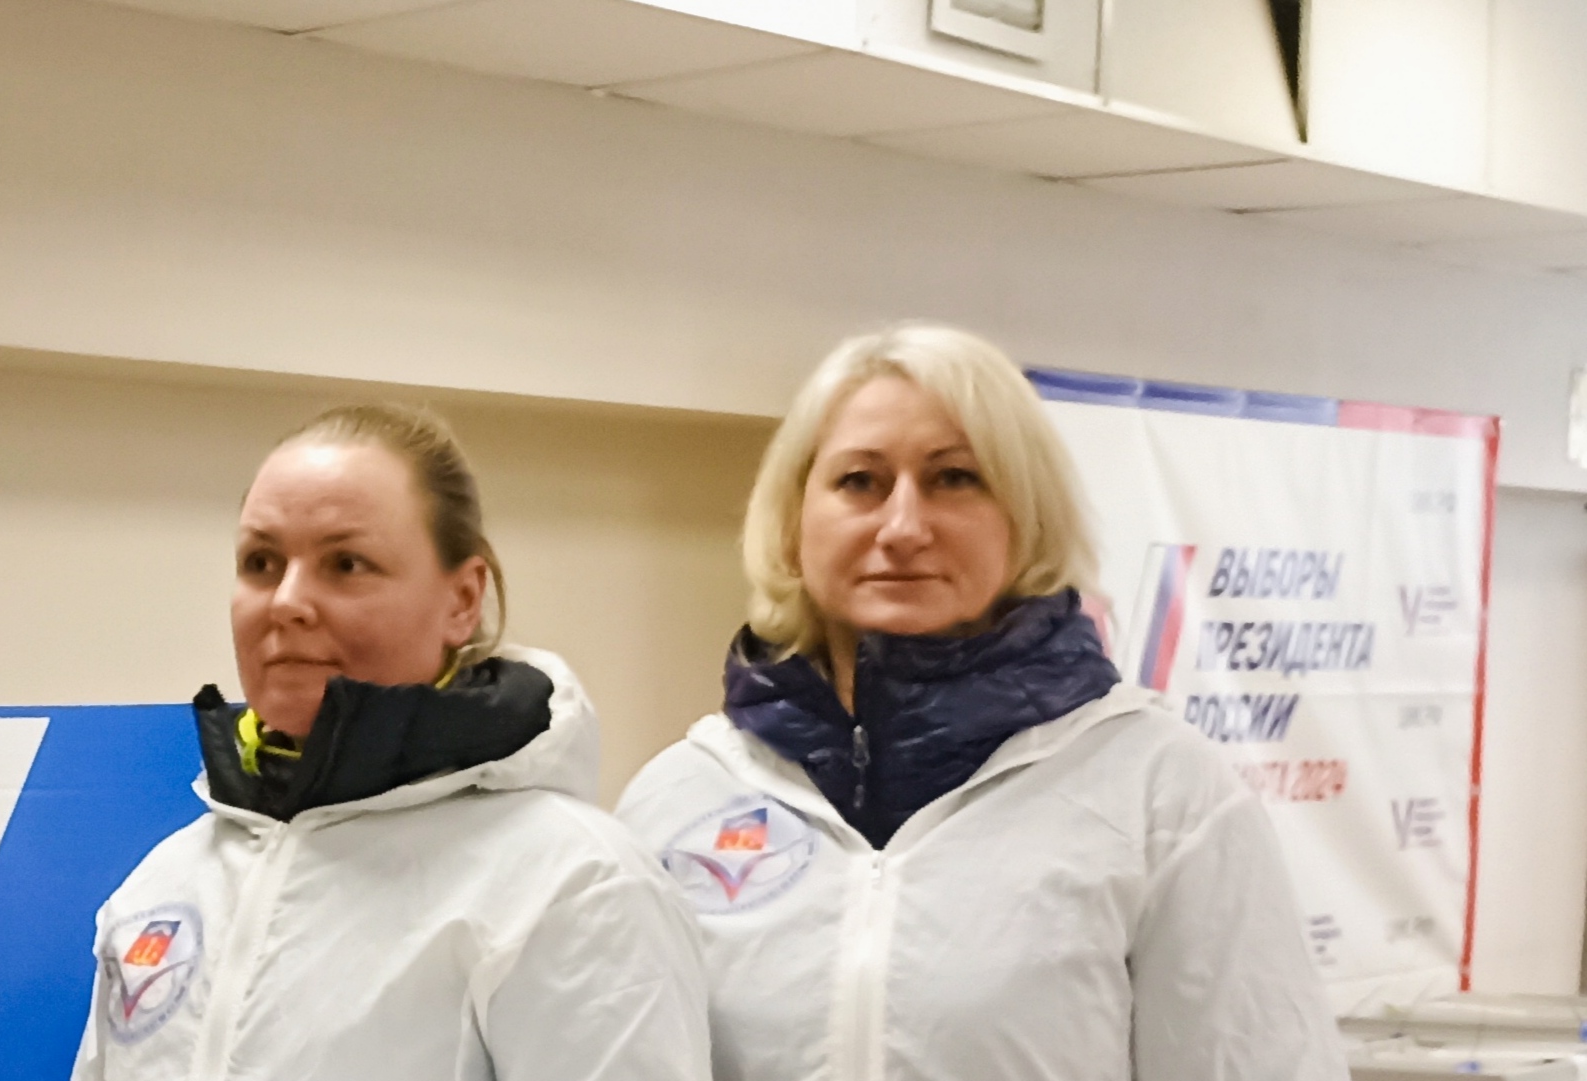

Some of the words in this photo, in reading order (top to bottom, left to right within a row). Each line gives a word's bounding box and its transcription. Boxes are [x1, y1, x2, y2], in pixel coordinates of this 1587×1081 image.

[1208, 547, 1344, 598] ВЫБОРЫ
[1196, 620, 1375, 677] ПРЕЗИДЕНТА
[1184, 693, 1300, 743] РОССИИ
